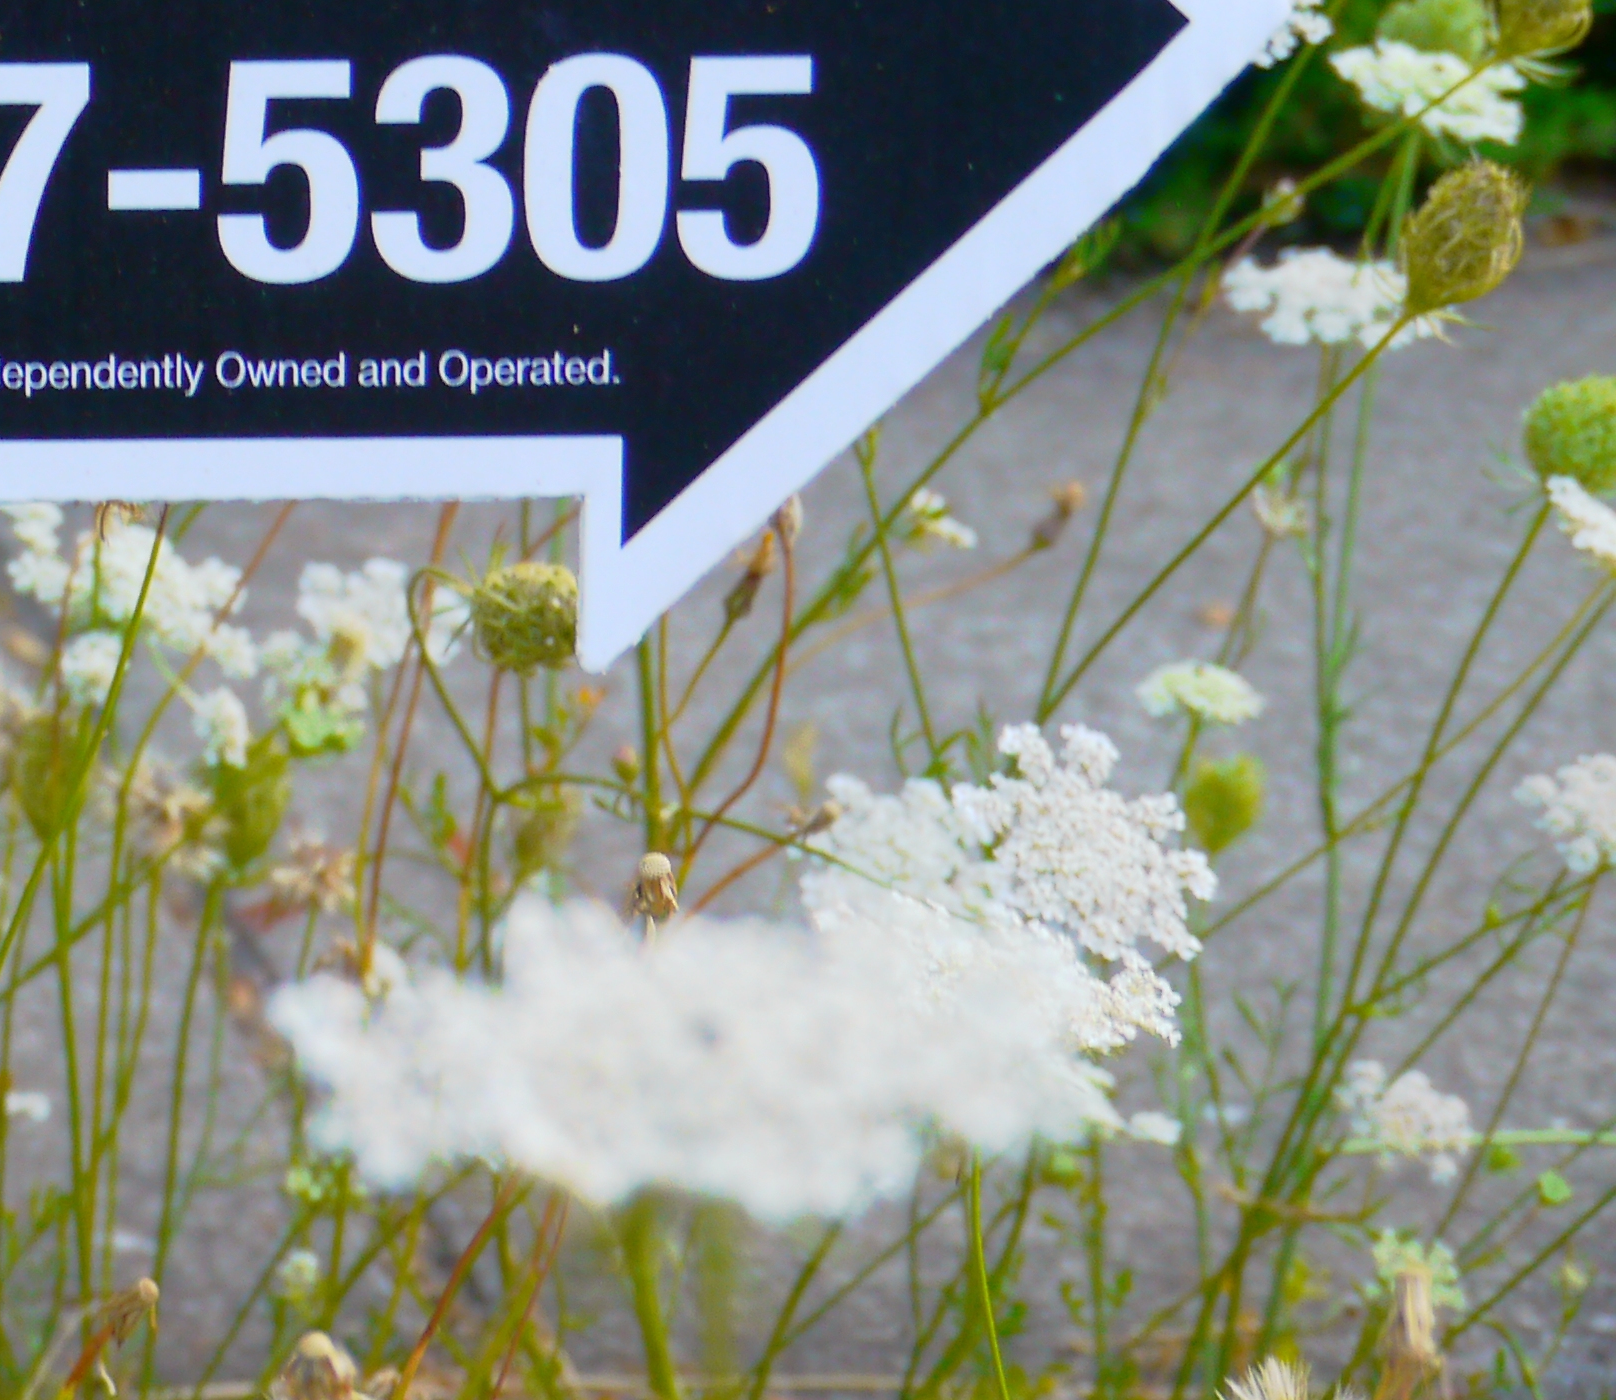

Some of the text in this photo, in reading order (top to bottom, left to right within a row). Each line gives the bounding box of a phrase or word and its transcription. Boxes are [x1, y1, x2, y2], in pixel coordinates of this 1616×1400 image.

[215, 351, 346, 388] Owned
[358, 350, 426, 387] and
[438, 349, 620, 395] Operated.
